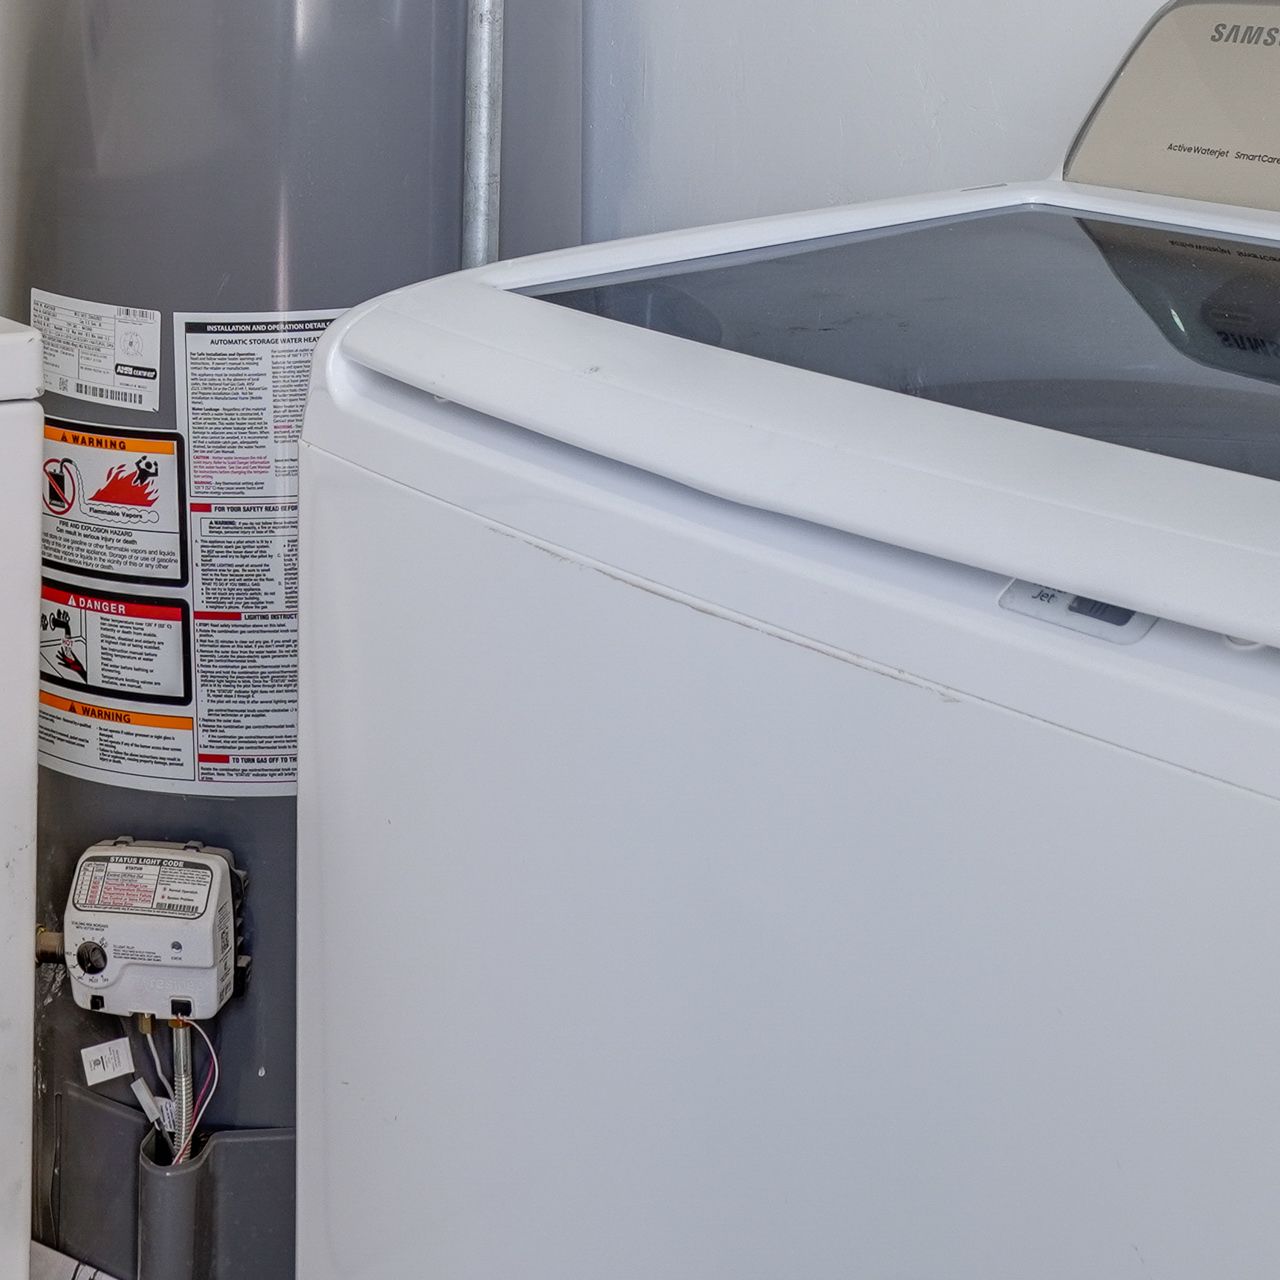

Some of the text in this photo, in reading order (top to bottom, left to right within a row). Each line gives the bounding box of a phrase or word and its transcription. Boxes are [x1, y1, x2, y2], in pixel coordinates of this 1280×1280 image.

[267, 323, 304, 331] OPERATION
[71, 434, 126, 450] WARNING
[89, 507, 120, 517] Flammable
[81, 524, 109, 534] EXPLOSION
[110, 529, 133, 537] HAZARD
[1032, 589, 1056, 603] Jet
[80, 598, 126, 614] DANGER
[81, 705, 131, 724] WARNING
[109, 856, 137, 864] STATUS
